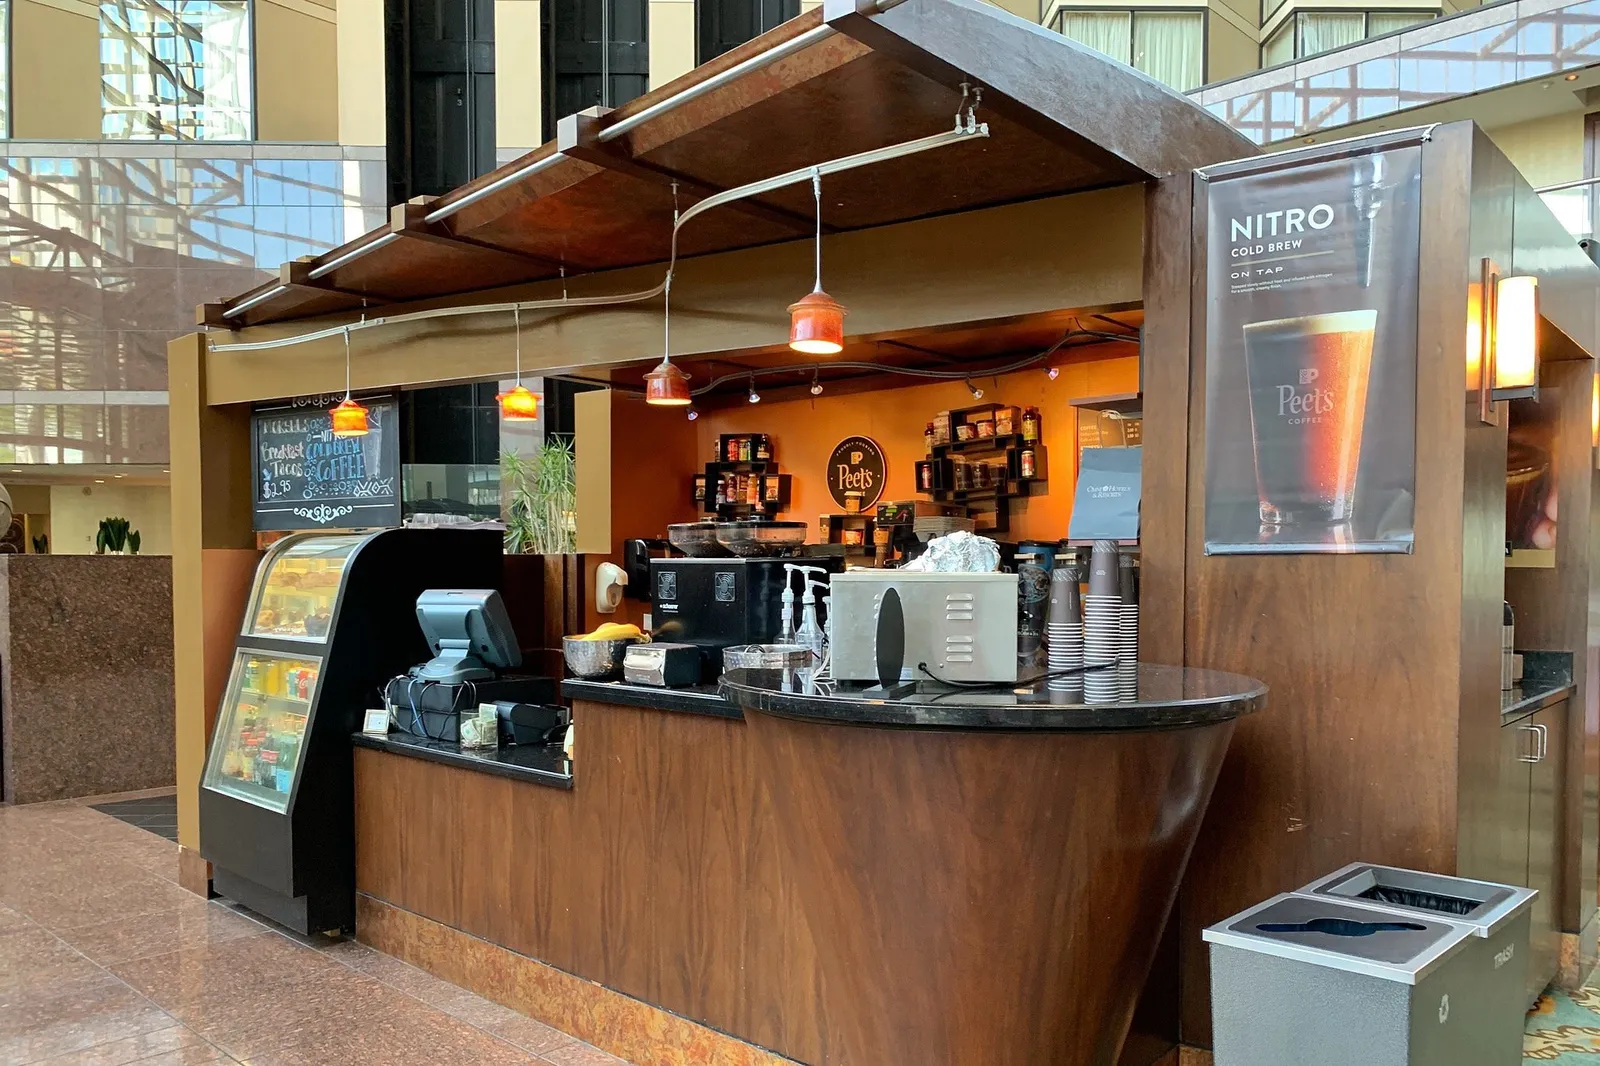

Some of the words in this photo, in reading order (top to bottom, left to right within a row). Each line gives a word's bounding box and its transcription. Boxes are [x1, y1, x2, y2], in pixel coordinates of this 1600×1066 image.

[1231, 204, 1334, 242] NITRO
[1231, 245, 1264, 257] COLD
[1268, 240, 1302, 252] BREW
[1256, 267, 1283, 276] TAP
[1276, 384, 1334, 416] Peet's
[306, 443, 332, 460] COLD
[333, 438, 360, 455] BREW
[270, 460, 303, 478] Tacos
[837, 464, 873, 489] Peet's
[263, 480, 291, 499] $2.95
[1494, 943, 1514, 970] TRASH
